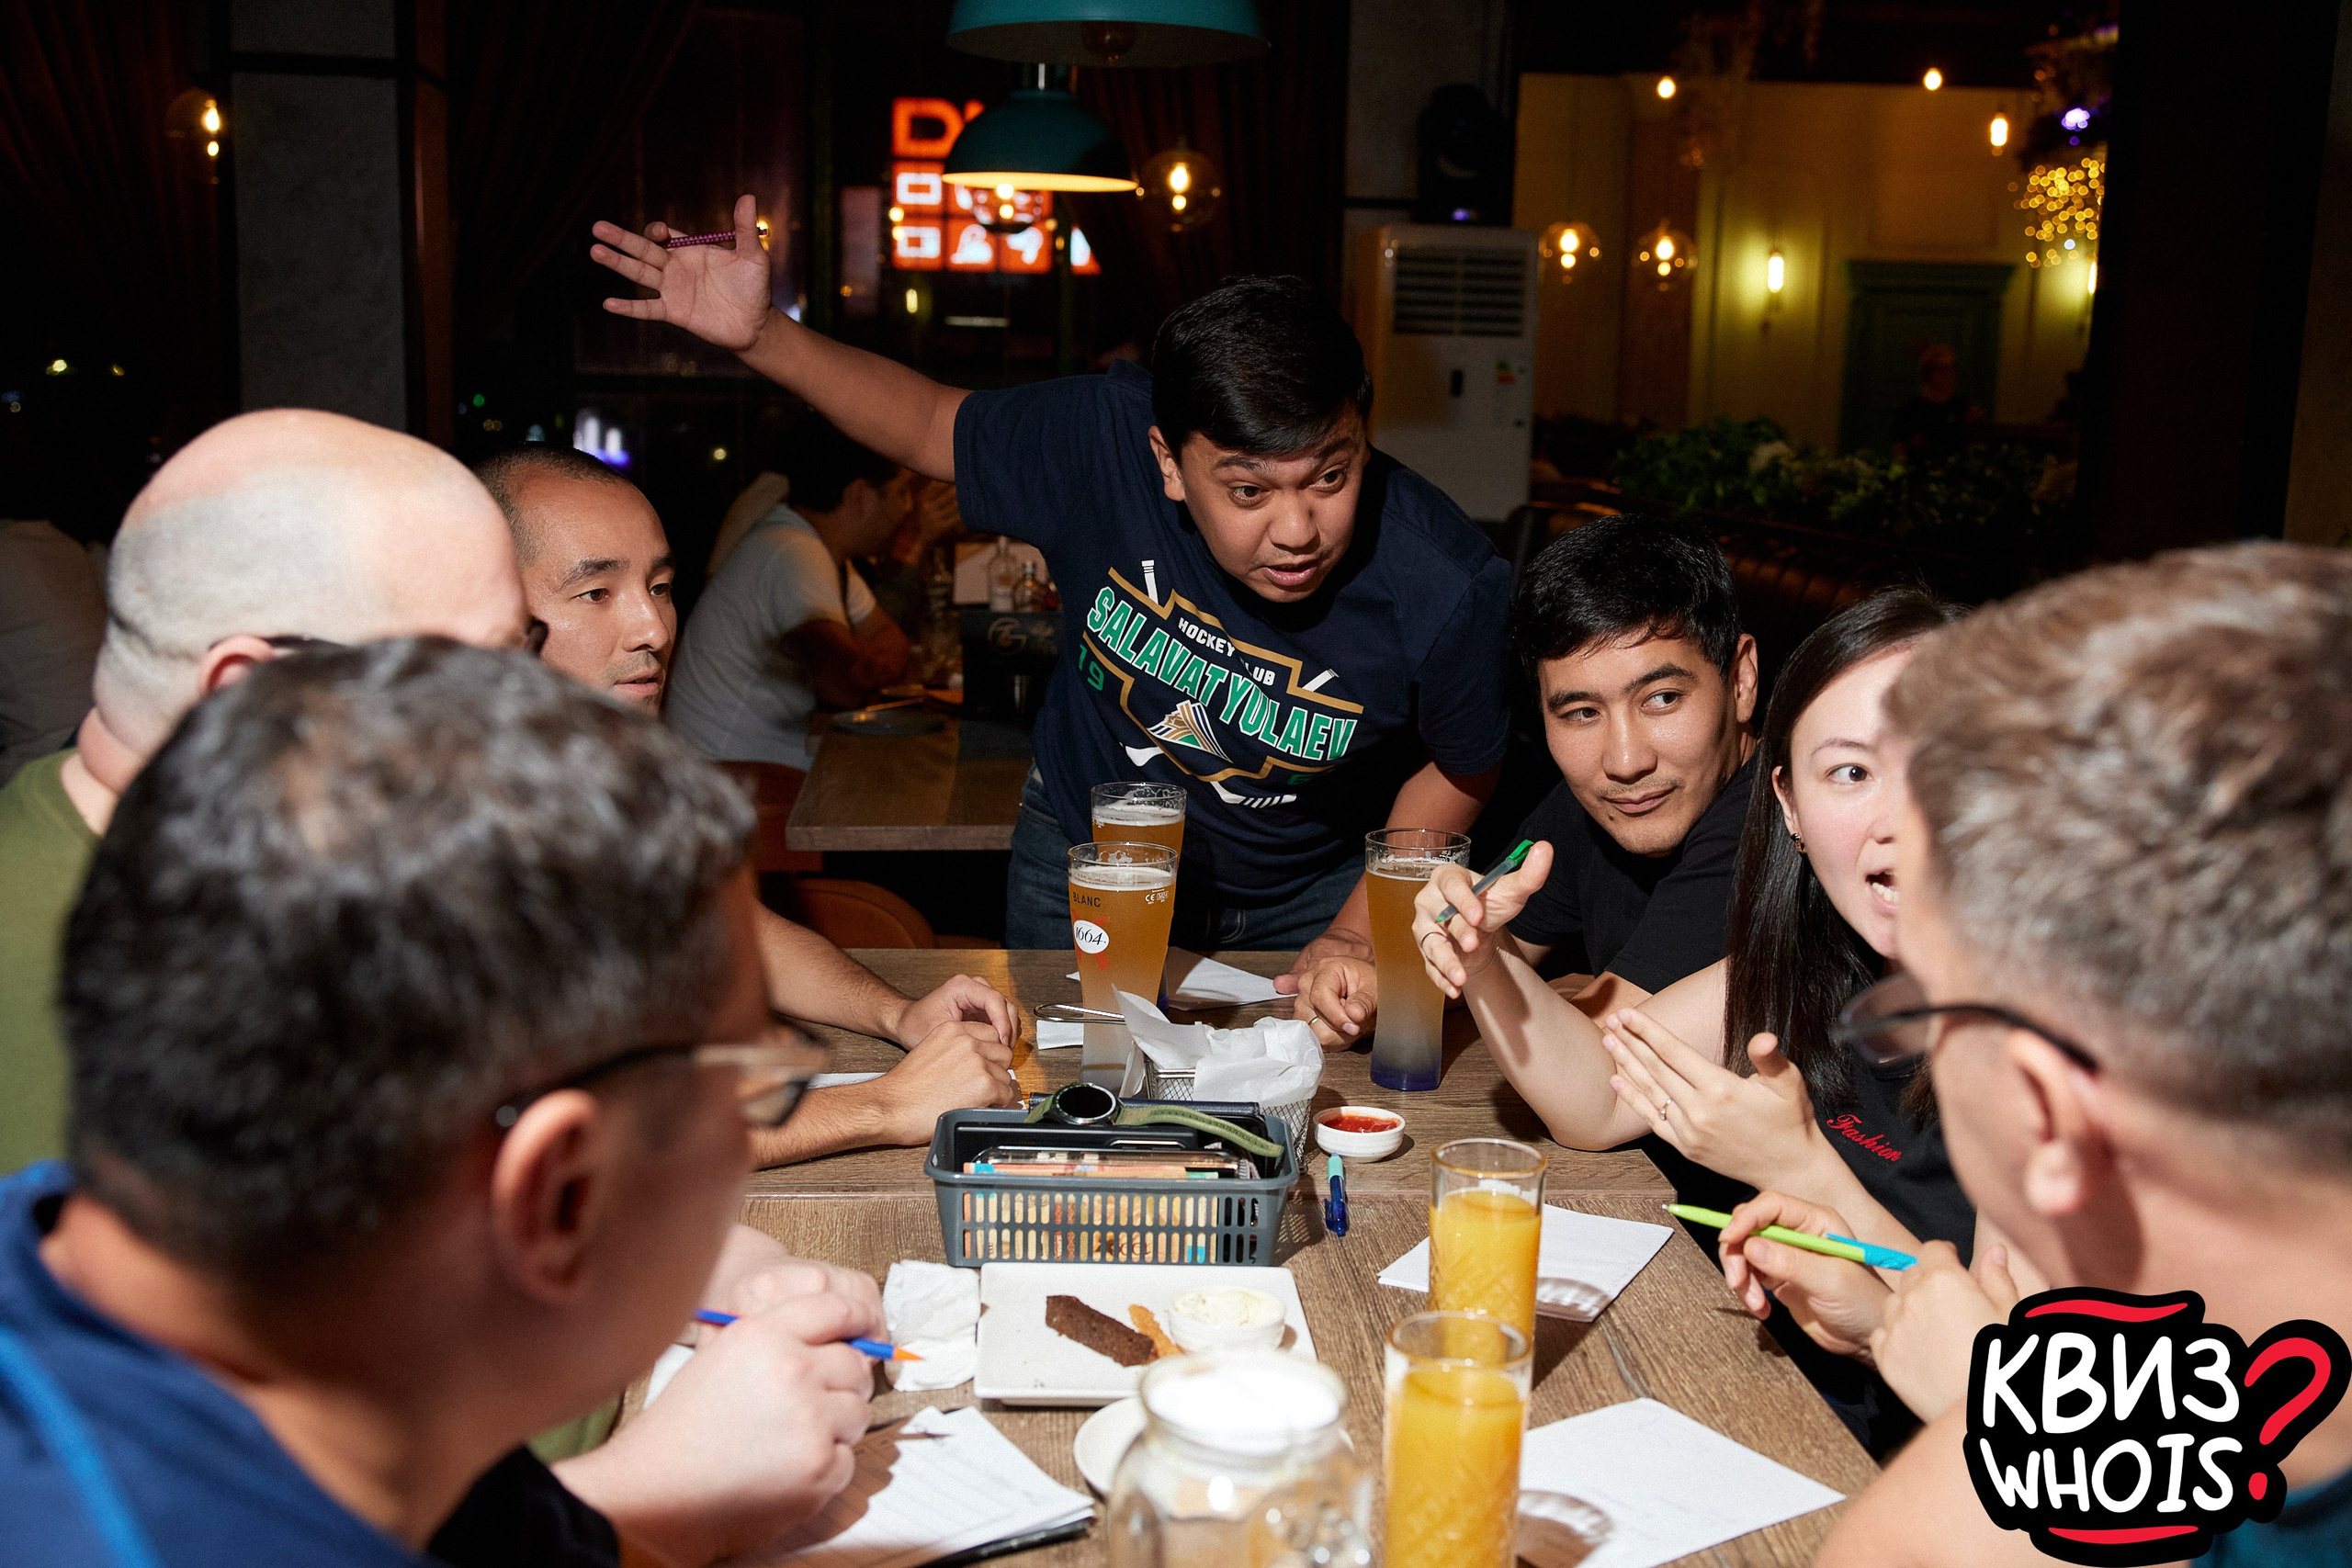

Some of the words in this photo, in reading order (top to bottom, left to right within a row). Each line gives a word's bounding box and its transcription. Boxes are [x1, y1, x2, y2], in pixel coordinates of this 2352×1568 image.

[1178, 617, 1236, 658] HOCKEY
[1239, 656, 1276, 686] UB
[1073, 891, 1102, 908] BLANC
[1826, 1113, 1902, 1161] Fashion
